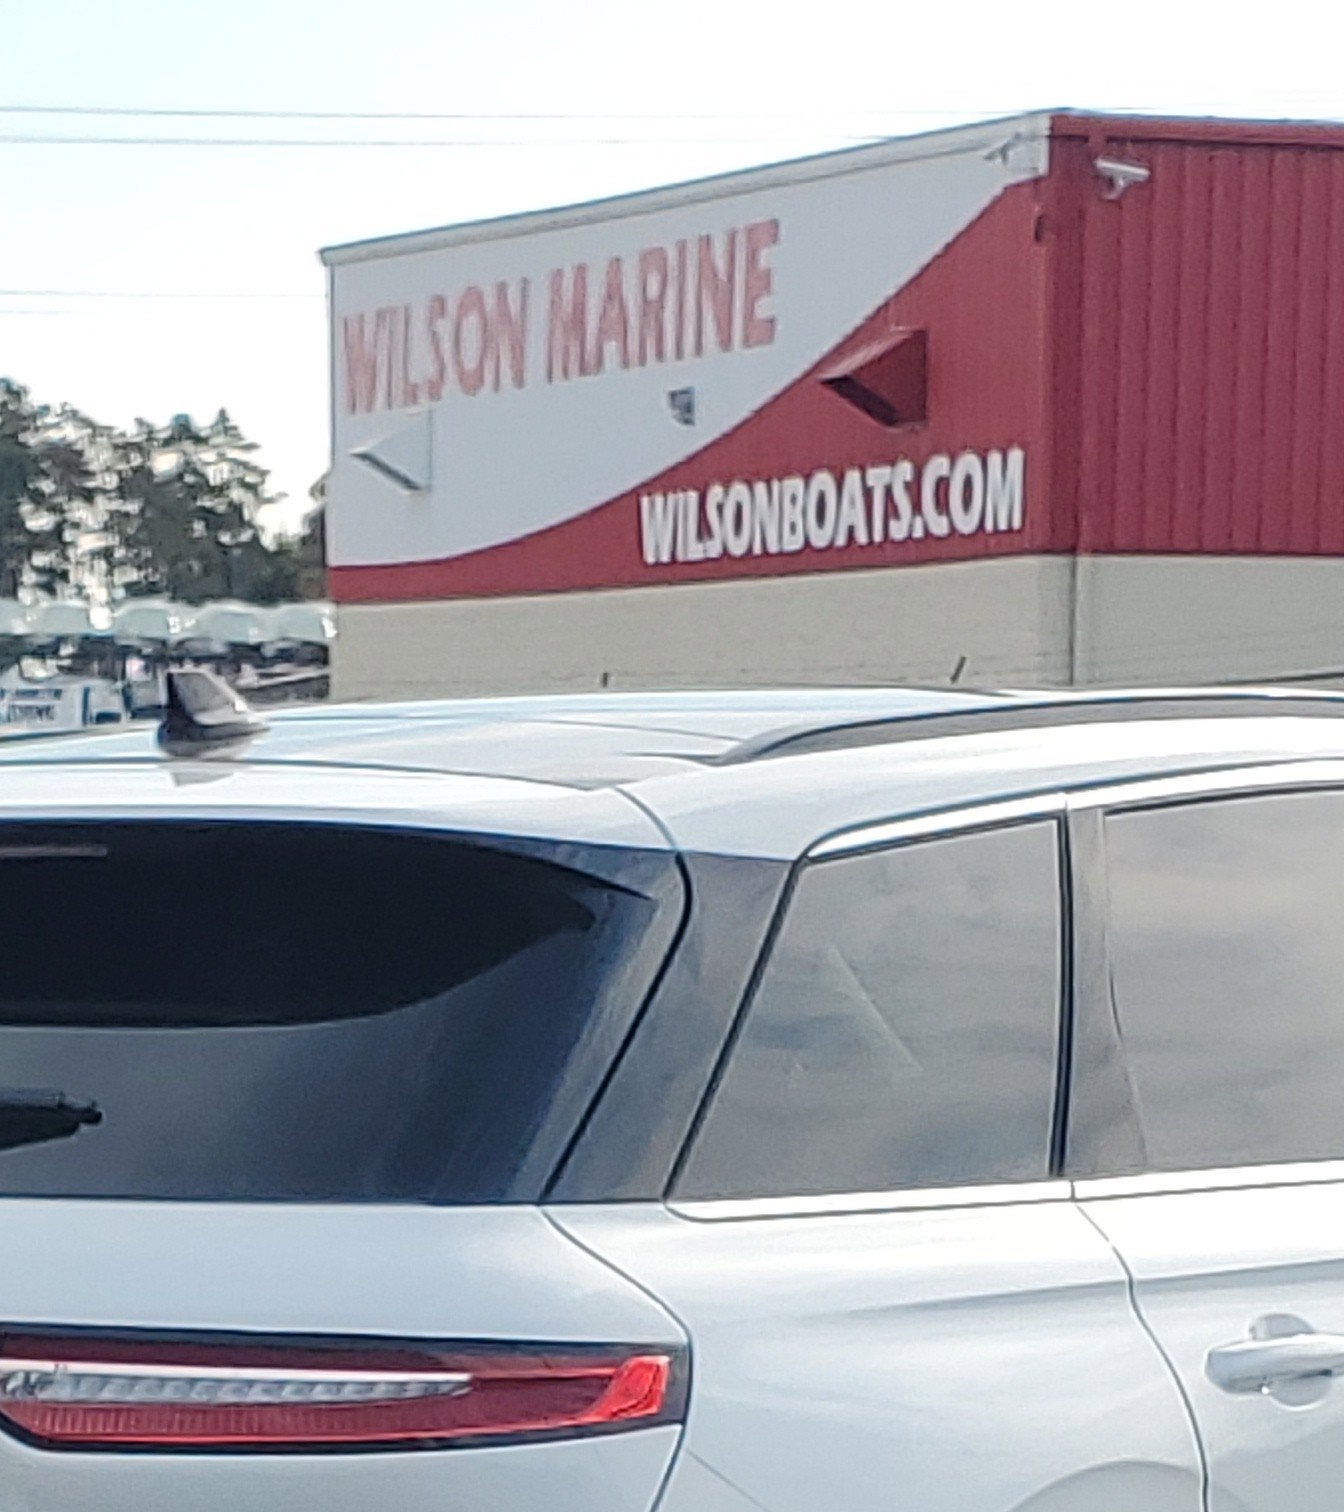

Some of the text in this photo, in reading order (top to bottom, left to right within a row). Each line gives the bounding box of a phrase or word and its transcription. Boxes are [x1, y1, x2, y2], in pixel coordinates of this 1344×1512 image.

[343, 218, 780, 415] WILSON MARINE
[638, 446, 1026, 566] WILSONBOATS.COM
